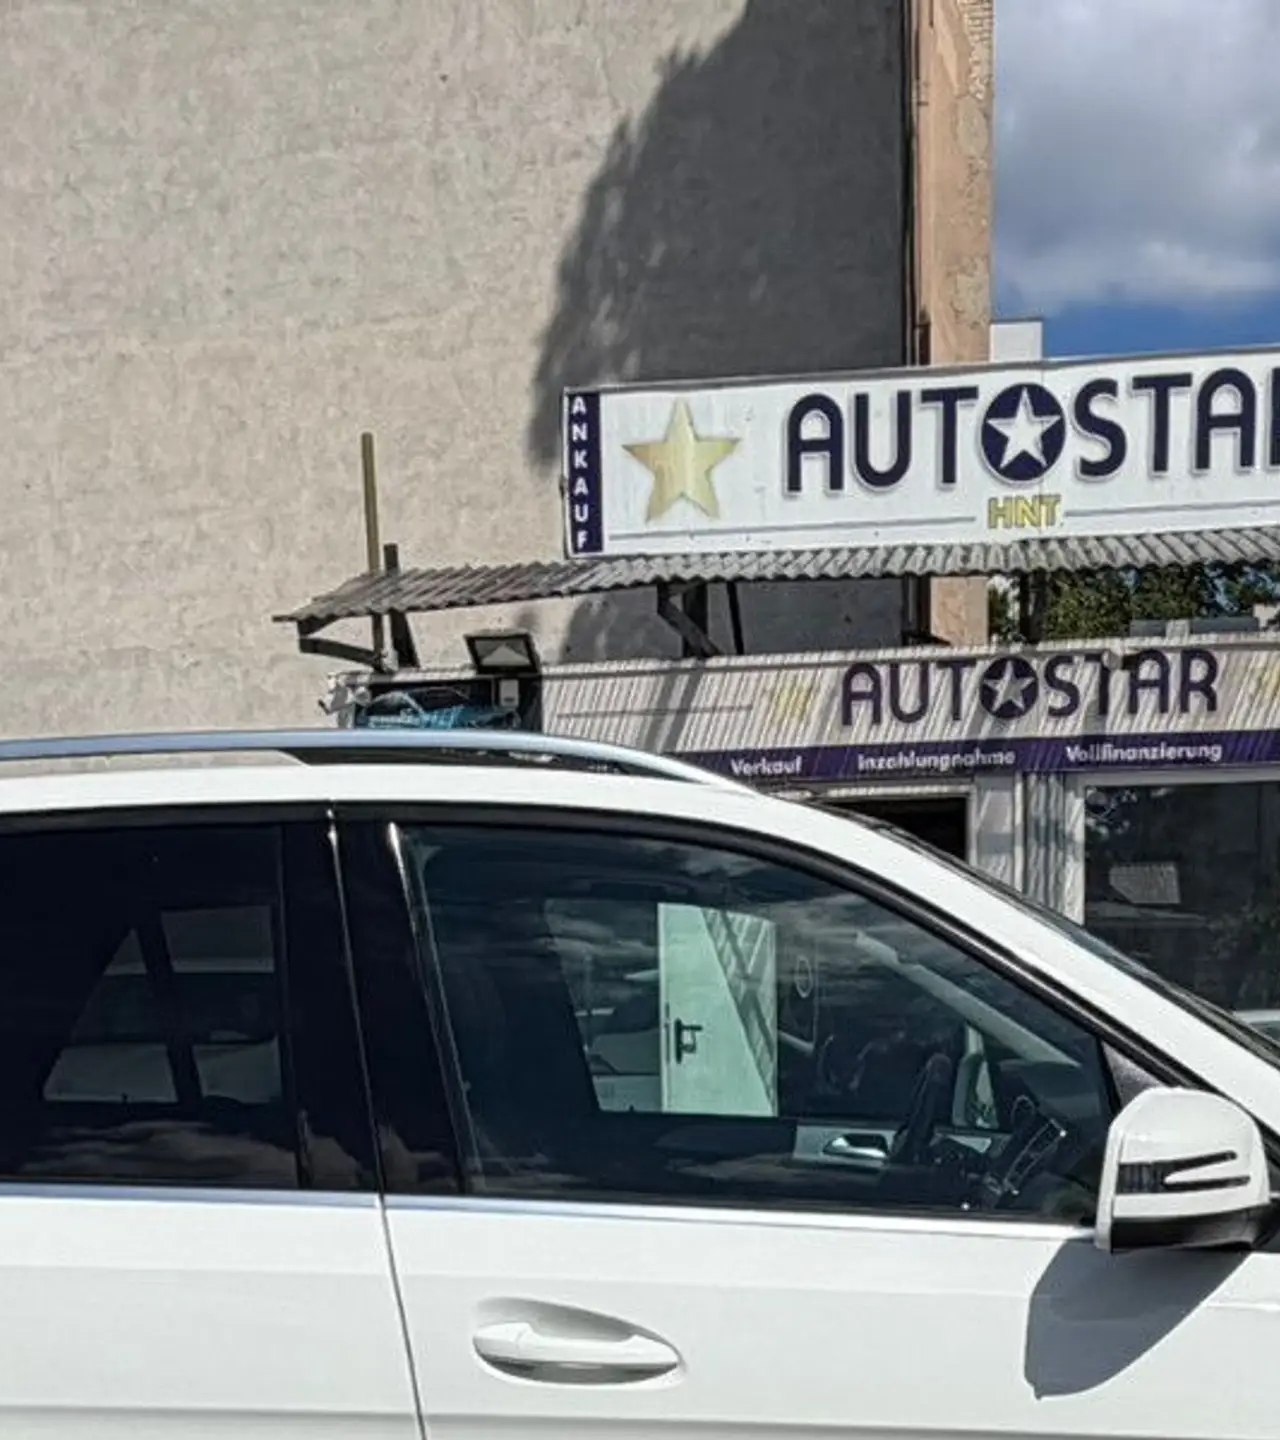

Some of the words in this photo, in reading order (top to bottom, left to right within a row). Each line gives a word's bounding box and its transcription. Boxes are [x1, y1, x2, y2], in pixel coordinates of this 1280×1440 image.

[571, 396, 589, 549] ANKAUF
[987, 494, 1061, 530] HNT
[841, 649, 1218, 727] AUTOSTAR
[730, 754, 804, 777] Verkauf
[858, 748, 1016, 773] Inzahlungnahme
[1066, 742, 1222, 765] Vollfinanzierung
